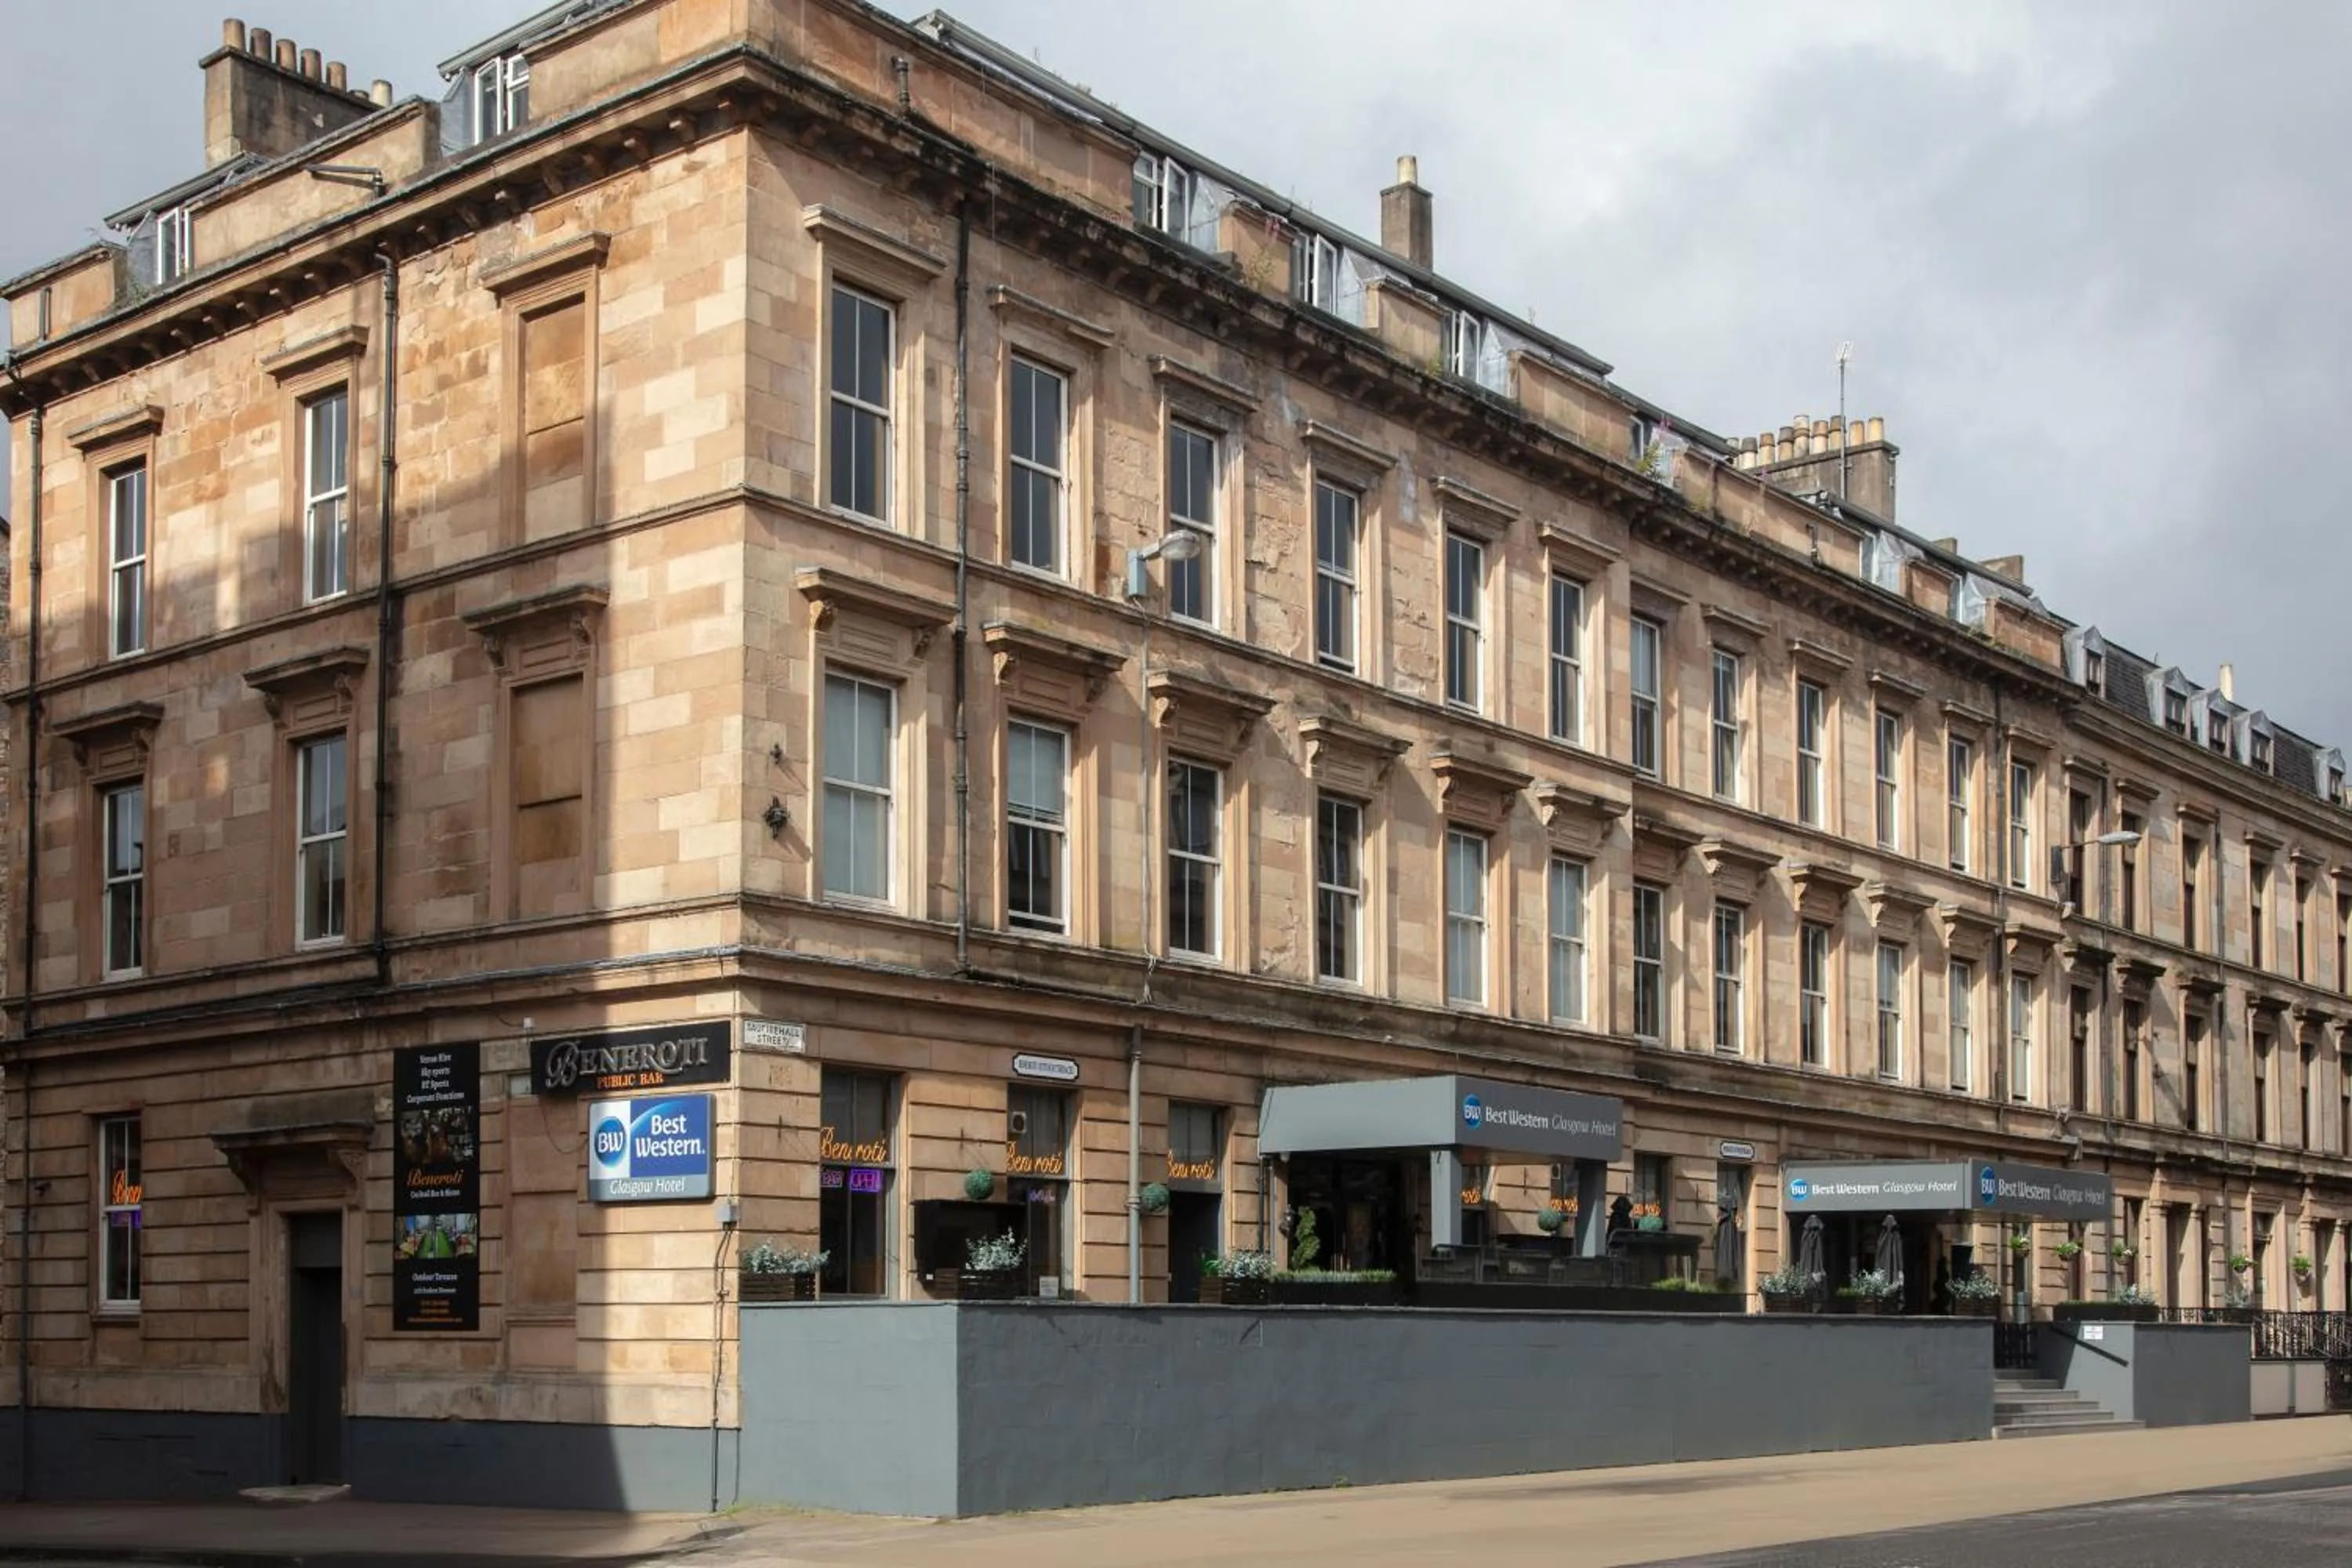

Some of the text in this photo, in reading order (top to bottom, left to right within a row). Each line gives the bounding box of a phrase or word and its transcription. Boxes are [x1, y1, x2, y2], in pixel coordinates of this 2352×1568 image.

[545, 1037, 709, 1089] BENEROTI
[596, 1072, 665, 1089] PUBLIC BAR
[1464, 1104, 1480, 1120] BW
[1485, 1105, 1616, 1137] Best Western Glasgow Hotel
[652, 1114, 688, 1135] Best
[597, 1131, 623, 1153] BW
[821, 1127, 887, 1162] Benroti
[1007, 1141, 1062, 1174] Benroti
[610, 1177, 686, 1196] Glasgow Hotel
[1791, 1186, 1807, 1195] BW
[1812, 1180, 1957, 1195] Best Western Glasgow Hotel
